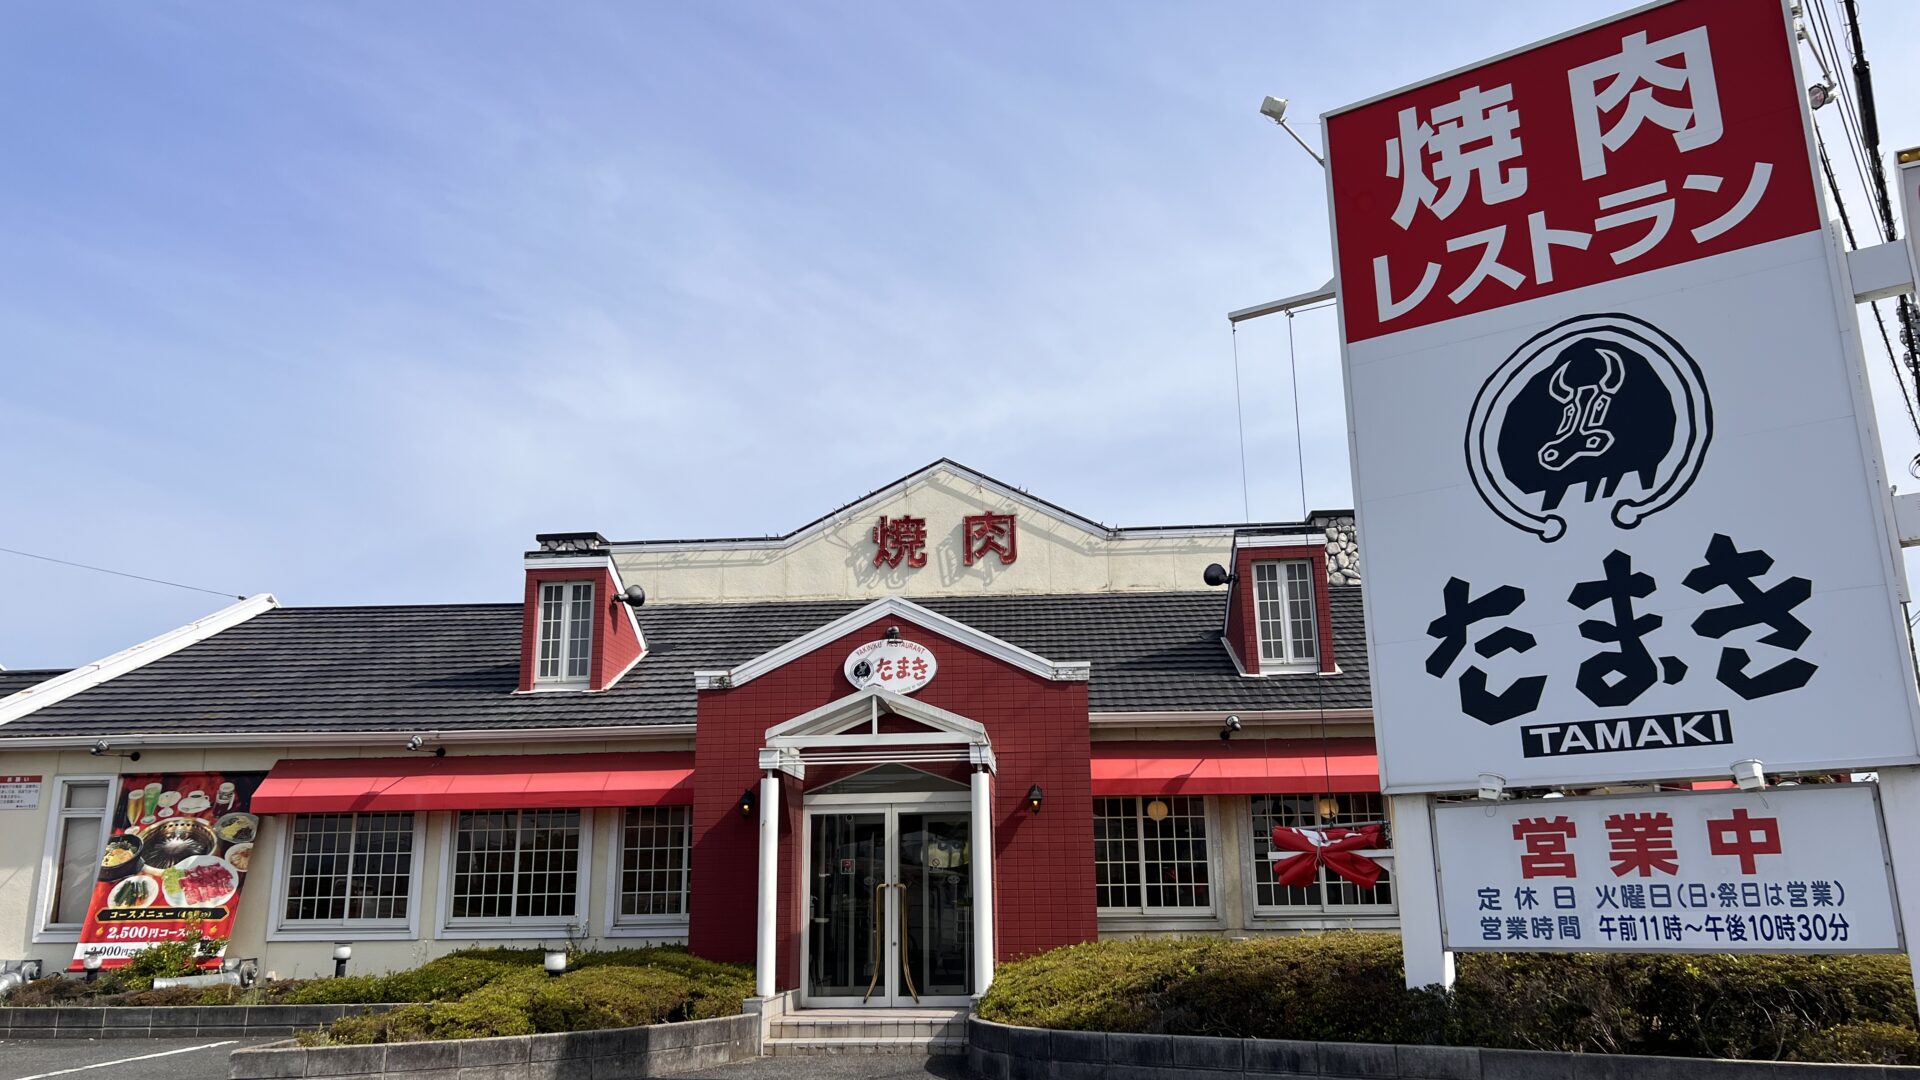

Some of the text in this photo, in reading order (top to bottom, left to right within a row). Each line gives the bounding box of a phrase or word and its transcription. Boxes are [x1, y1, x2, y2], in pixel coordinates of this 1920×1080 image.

[1385, 25, 1725, 231] 焼肉
[1372, 161, 1774, 323] レストラン
[872, 510, 1018, 569] 焼肉
[1425, 533, 1819, 726] たまき
[876, 656, 928, 681] たまき
[1528, 712, 1725, 755] TAMAKI
[1512, 808, 1783, 879] 営業中
[1477, 885, 1577, 912] 定休日
[1480, 916, 1582, 941] 営業時間
